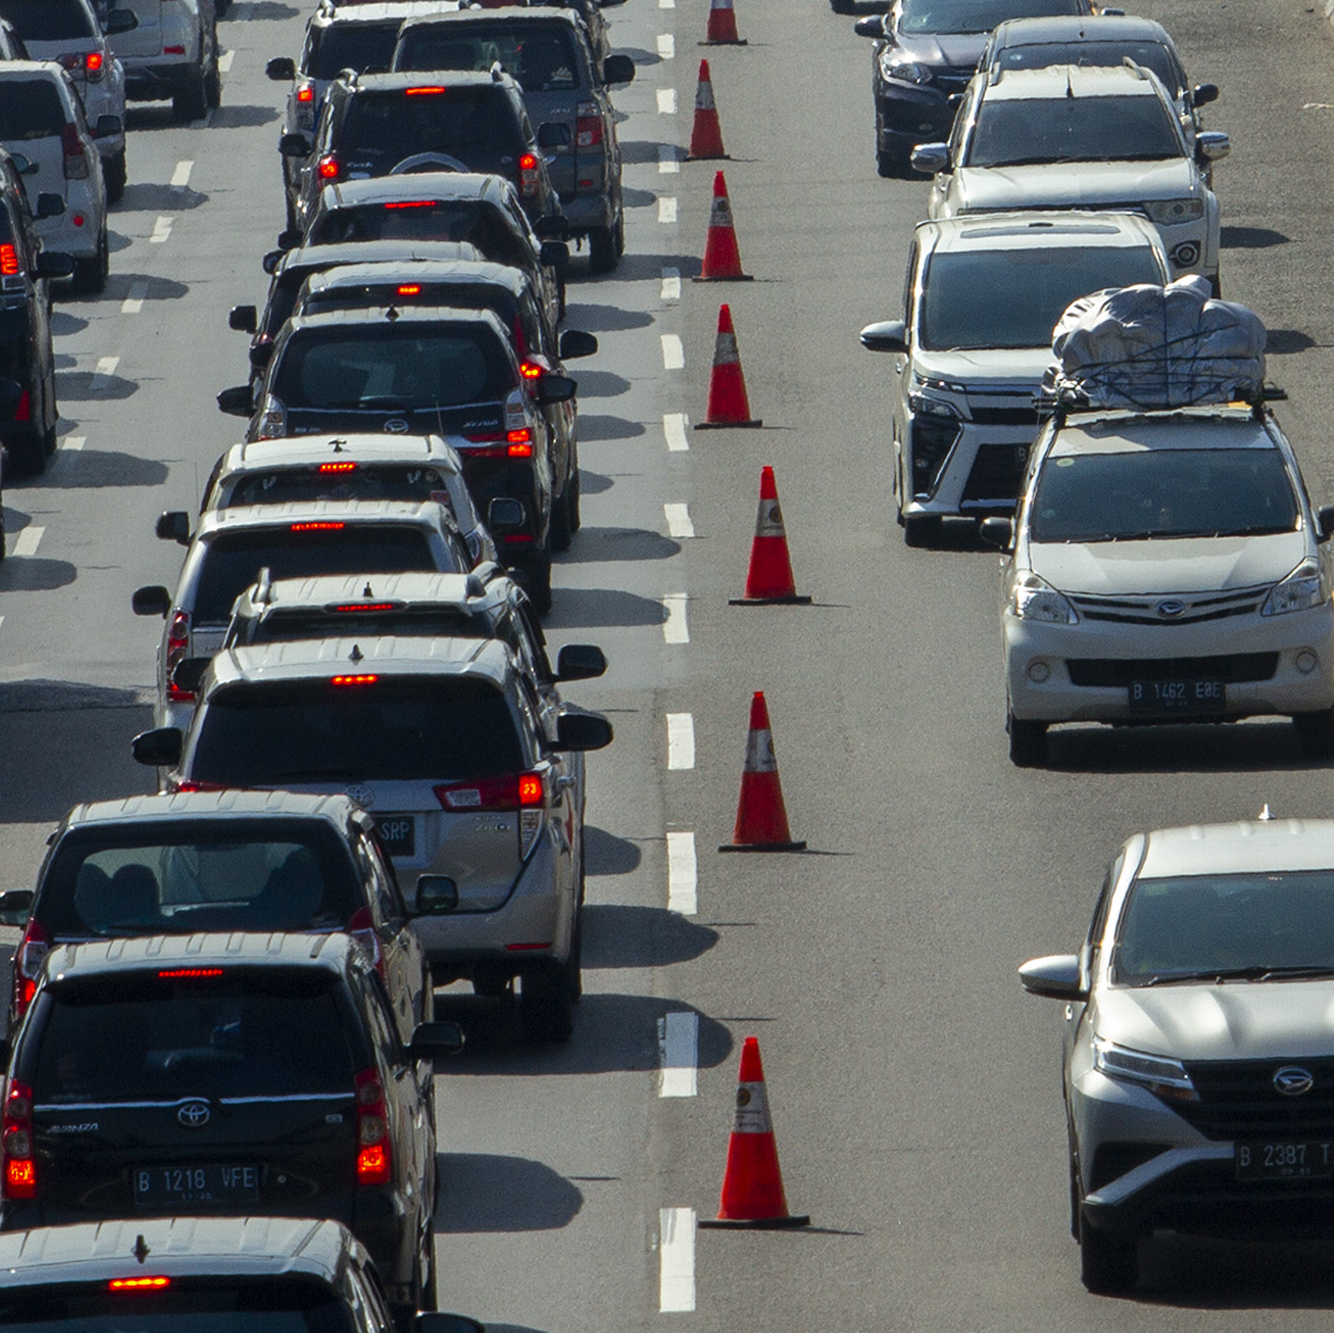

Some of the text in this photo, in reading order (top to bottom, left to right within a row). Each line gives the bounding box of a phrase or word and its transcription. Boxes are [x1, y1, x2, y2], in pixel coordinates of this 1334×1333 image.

[1133, 683, 1143, 700] B
[1154, 682, 1186, 699] 1462
[381, 821, 410, 841] SRP
[46, 1122, 100, 1133] AVANZA
[1240, 1146, 1251, 1167] B
[1263, 1144, 1307, 1166] 2387
[139, 1166, 254, 1192] B 1218 VFE
